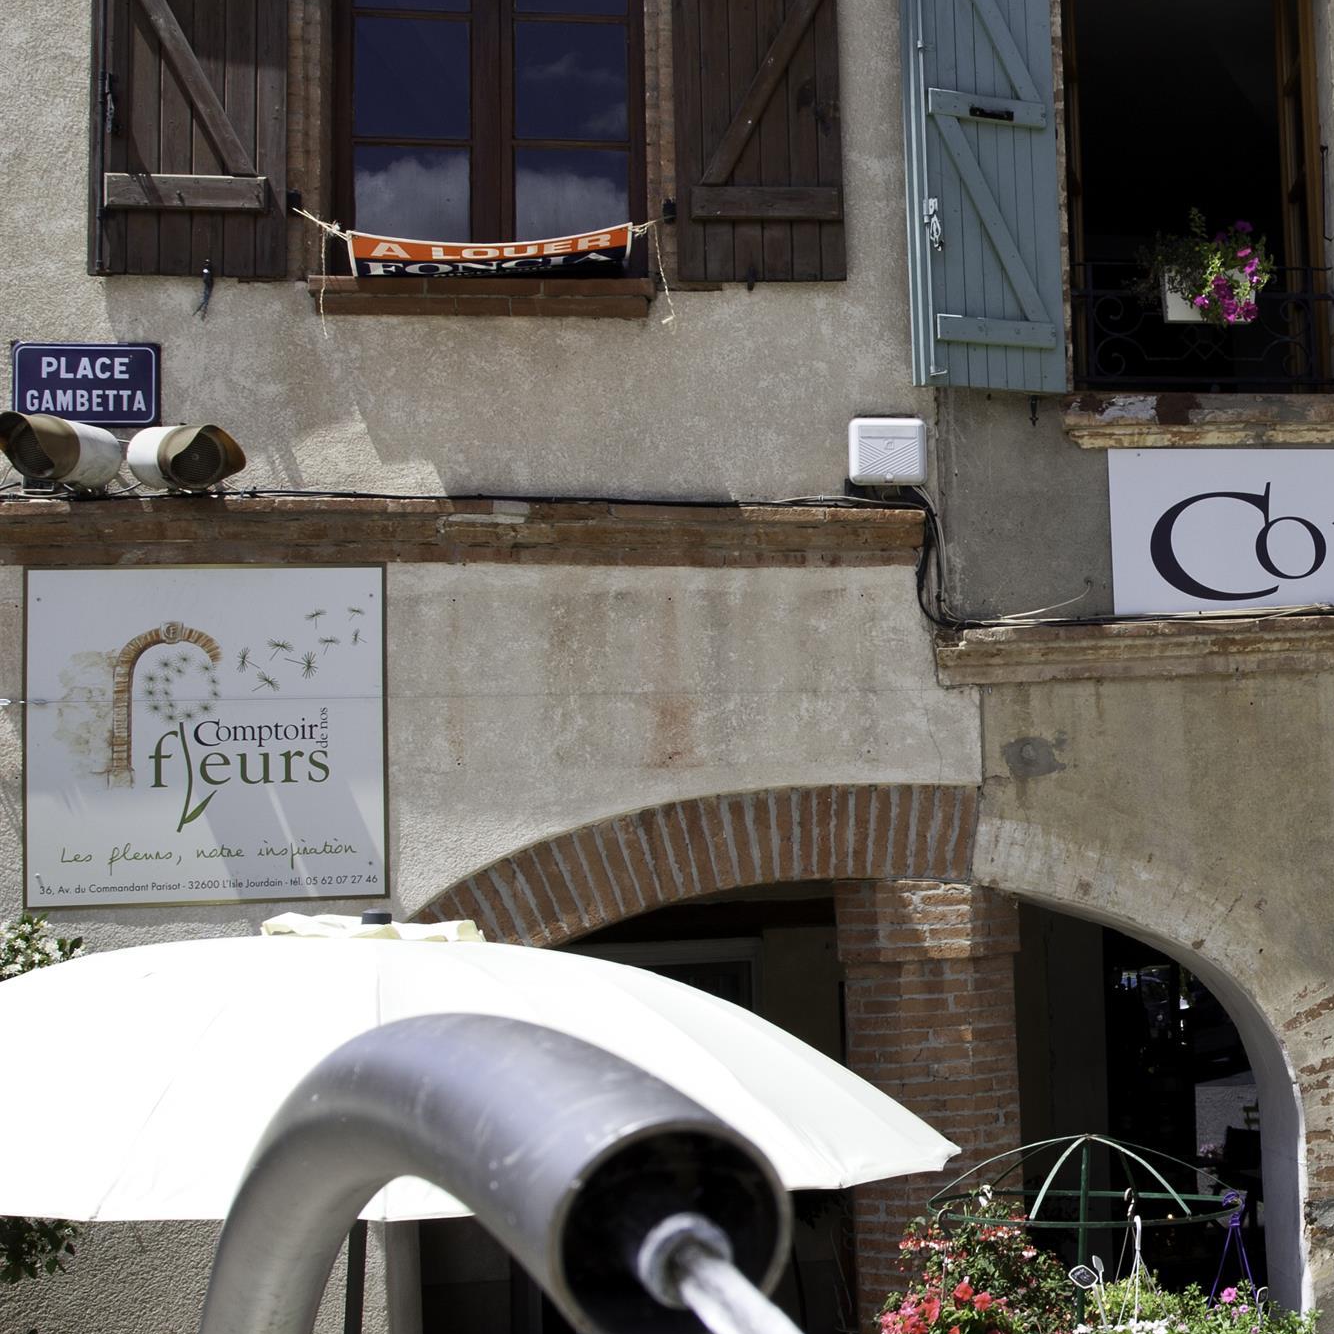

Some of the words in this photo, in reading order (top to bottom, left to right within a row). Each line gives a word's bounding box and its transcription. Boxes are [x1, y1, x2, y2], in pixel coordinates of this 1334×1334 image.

[371, 242, 411, 259] A
[431, 234, 611, 260] LOUER
[41, 356, 130, 381] PLACE
[25, 389, 146, 413] GAMBETTA
[319, 707, 328, 729] nos
[194, 718, 318, 747] Comptoir
[316, 732, 328, 749] de
[148, 722, 330, 833] fleurs
[60, 847, 93, 864] Les
[196, 843, 245, 860] notre
[257, 838, 358, 870] inspiration
[39, 886, 55, 896] 36,
[57, 886, 72, 894] Av.
[75, 885, 86, 894] du
[89, 882, 149, 894] Commandant
[151, 881, 181, 891] Parisot
[188, 880, 220, 890] 32600
[222, 879, 243, 888] L'Isle
[245, 878, 283, 888] Jourdain
[290, 877, 303, 887] tél.
[305, 877, 319, 886] 05
[321, 876, 333, 885] 62
[336, 876, 348, 884] 07
[351, 875, 363, 884] 27
[365, 874, 378, 883] 46
